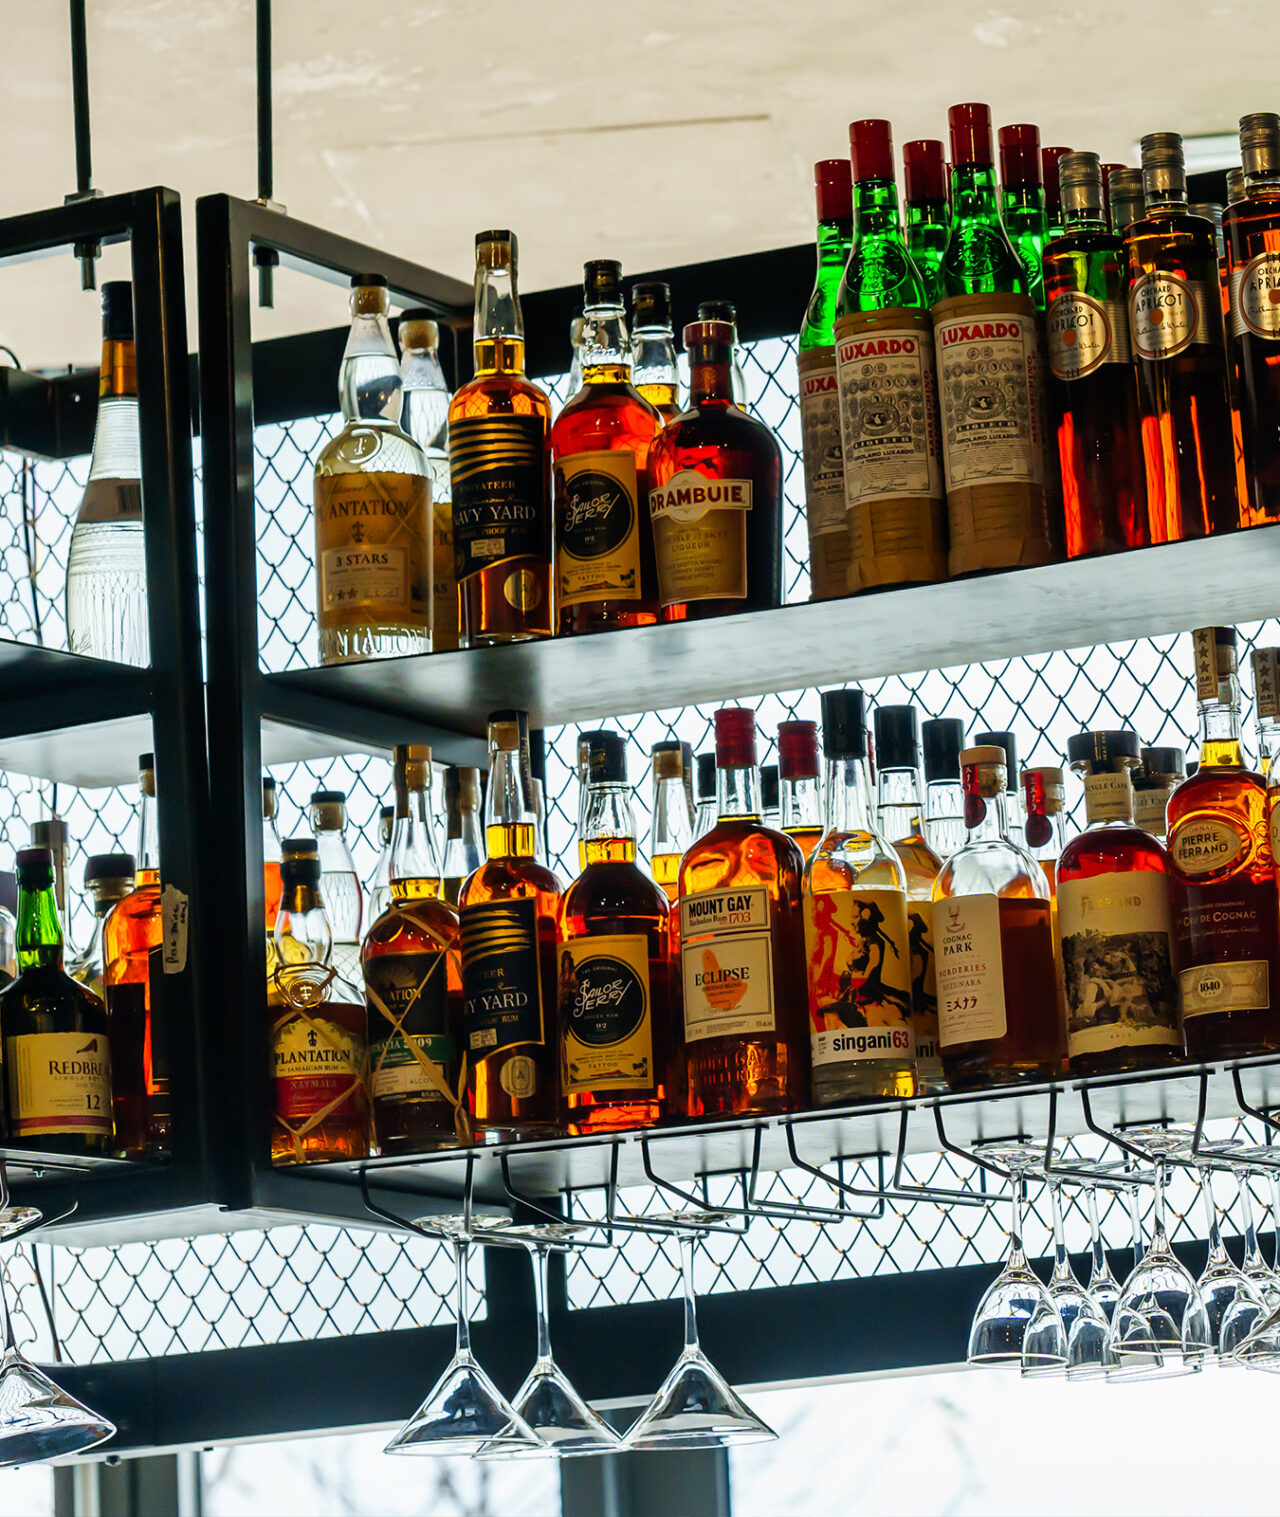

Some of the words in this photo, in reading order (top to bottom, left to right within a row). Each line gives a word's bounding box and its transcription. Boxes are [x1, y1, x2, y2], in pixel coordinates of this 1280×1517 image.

[1141, 285, 1171, 297] ORCHARD
[1135, 293, 1183, 314] APRICOT
[1056, 306, 1084, 318] ORCHARD
[942, 323, 1020, 346] LUXARDO
[840, 339, 915, 363] LUXARDO
[803, 376, 838, 396] UXA
[989, 432, 1021, 440] LUXARDO
[566, 493, 611, 519] SAILOR
[650, 485, 743, 514] DRAMBUIE
[489, 505, 536, 521] YARD
[564, 494, 621, 532] JERRY
[336, 556, 343, 567] 3
[346, 554, 388, 566] STARS
[1182, 833, 1219, 846] PIERRE
[1179, 843, 1228, 859] FERRAND
[689, 898, 724, 918] MOUNT
[727, 895, 752, 911] GAY
[713, 914, 727, 922] Rum
[729, 911, 751, 924] 1703
[1213, 911, 1257, 923] COGNAC
[943, 933, 972, 944] COGNAC
[944, 942, 972, 956] PARK
[695, 967, 750, 986] ECLIPSE
[940, 963, 987, 978] BORDERIES
[576, 979, 623, 1005] SAILOR
[943, 979, 981, 991] MIZUNARA
[1200, 978, 1220, 992] 1840
[481, 991, 528, 1011] YARD
[573, 979, 633, 1018] JERRY
[502, 1015, 519, 1023] RUM
[403, 1037, 432, 1049] 209
[833, 1030, 909, 1053] singani63
[274, 1049, 351, 1065] PLANTATION
[86, 1094, 101, 1110] 12
